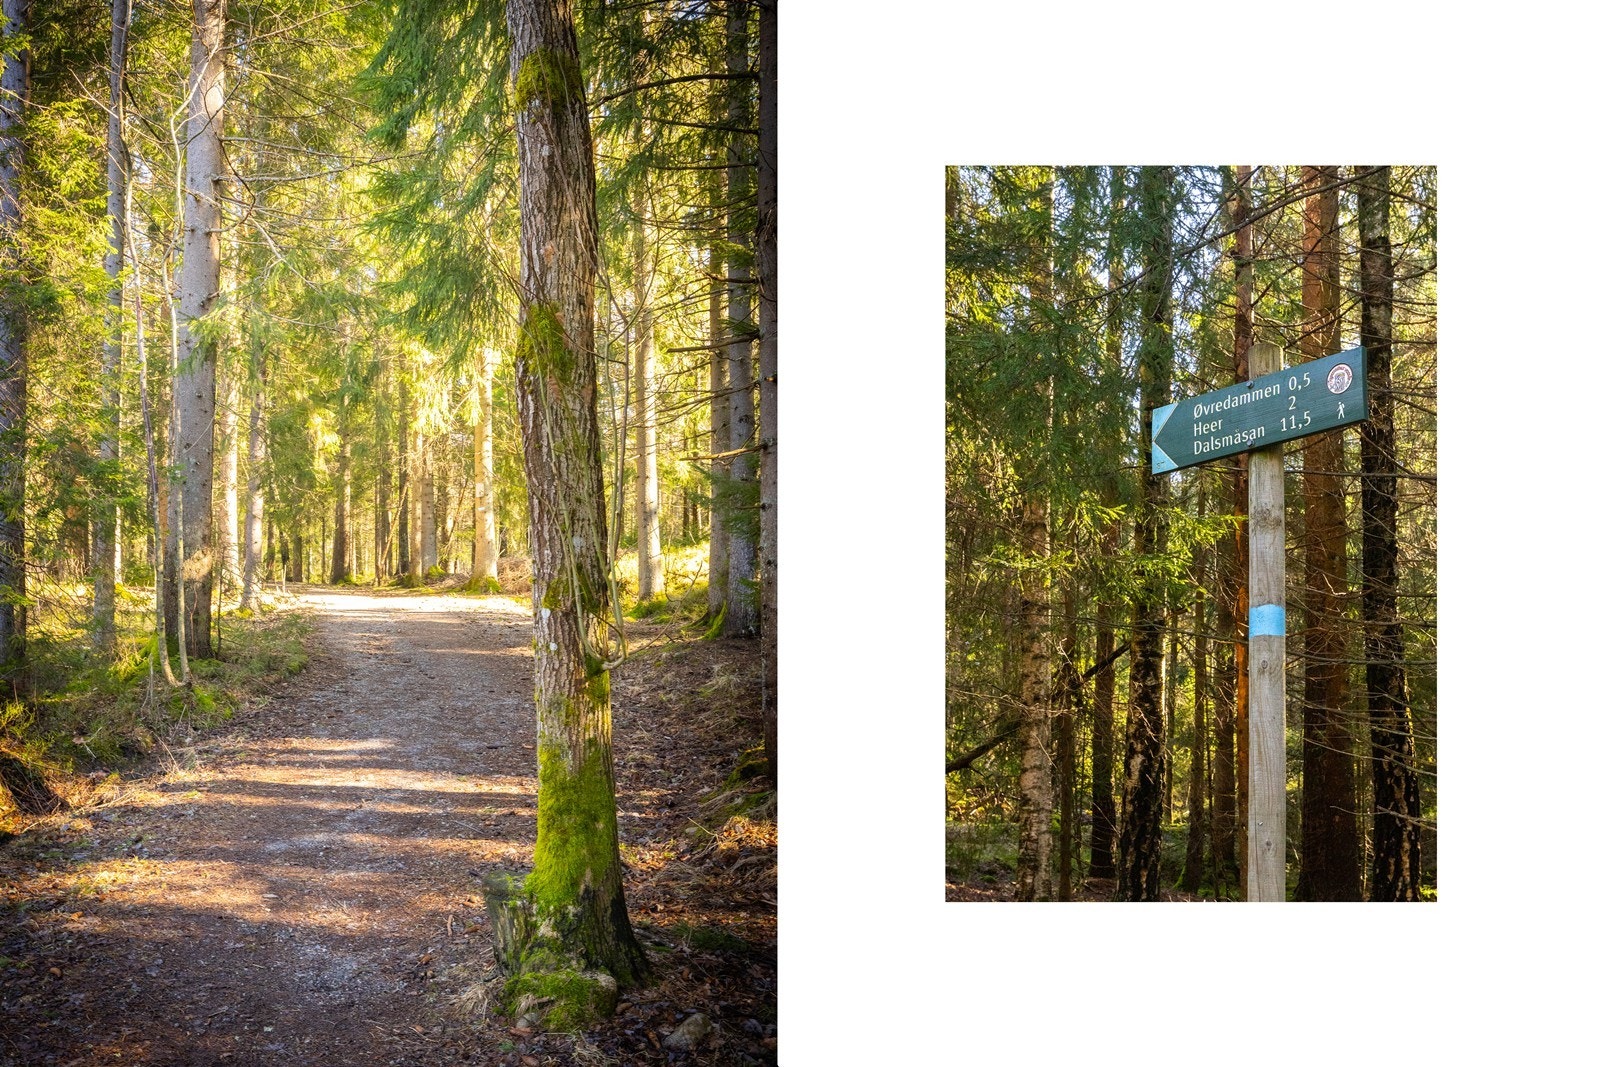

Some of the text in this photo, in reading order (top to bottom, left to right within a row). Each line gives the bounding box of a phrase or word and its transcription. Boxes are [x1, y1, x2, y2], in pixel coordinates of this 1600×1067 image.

[1193, 383, 1281, 419] Øvredammen
[1288, 372, 1311, 391] 0,5
[1193, 396, 1297, 437] Heer 2
[1193, 411, 1311, 455] Dalsmåsan 11,5
